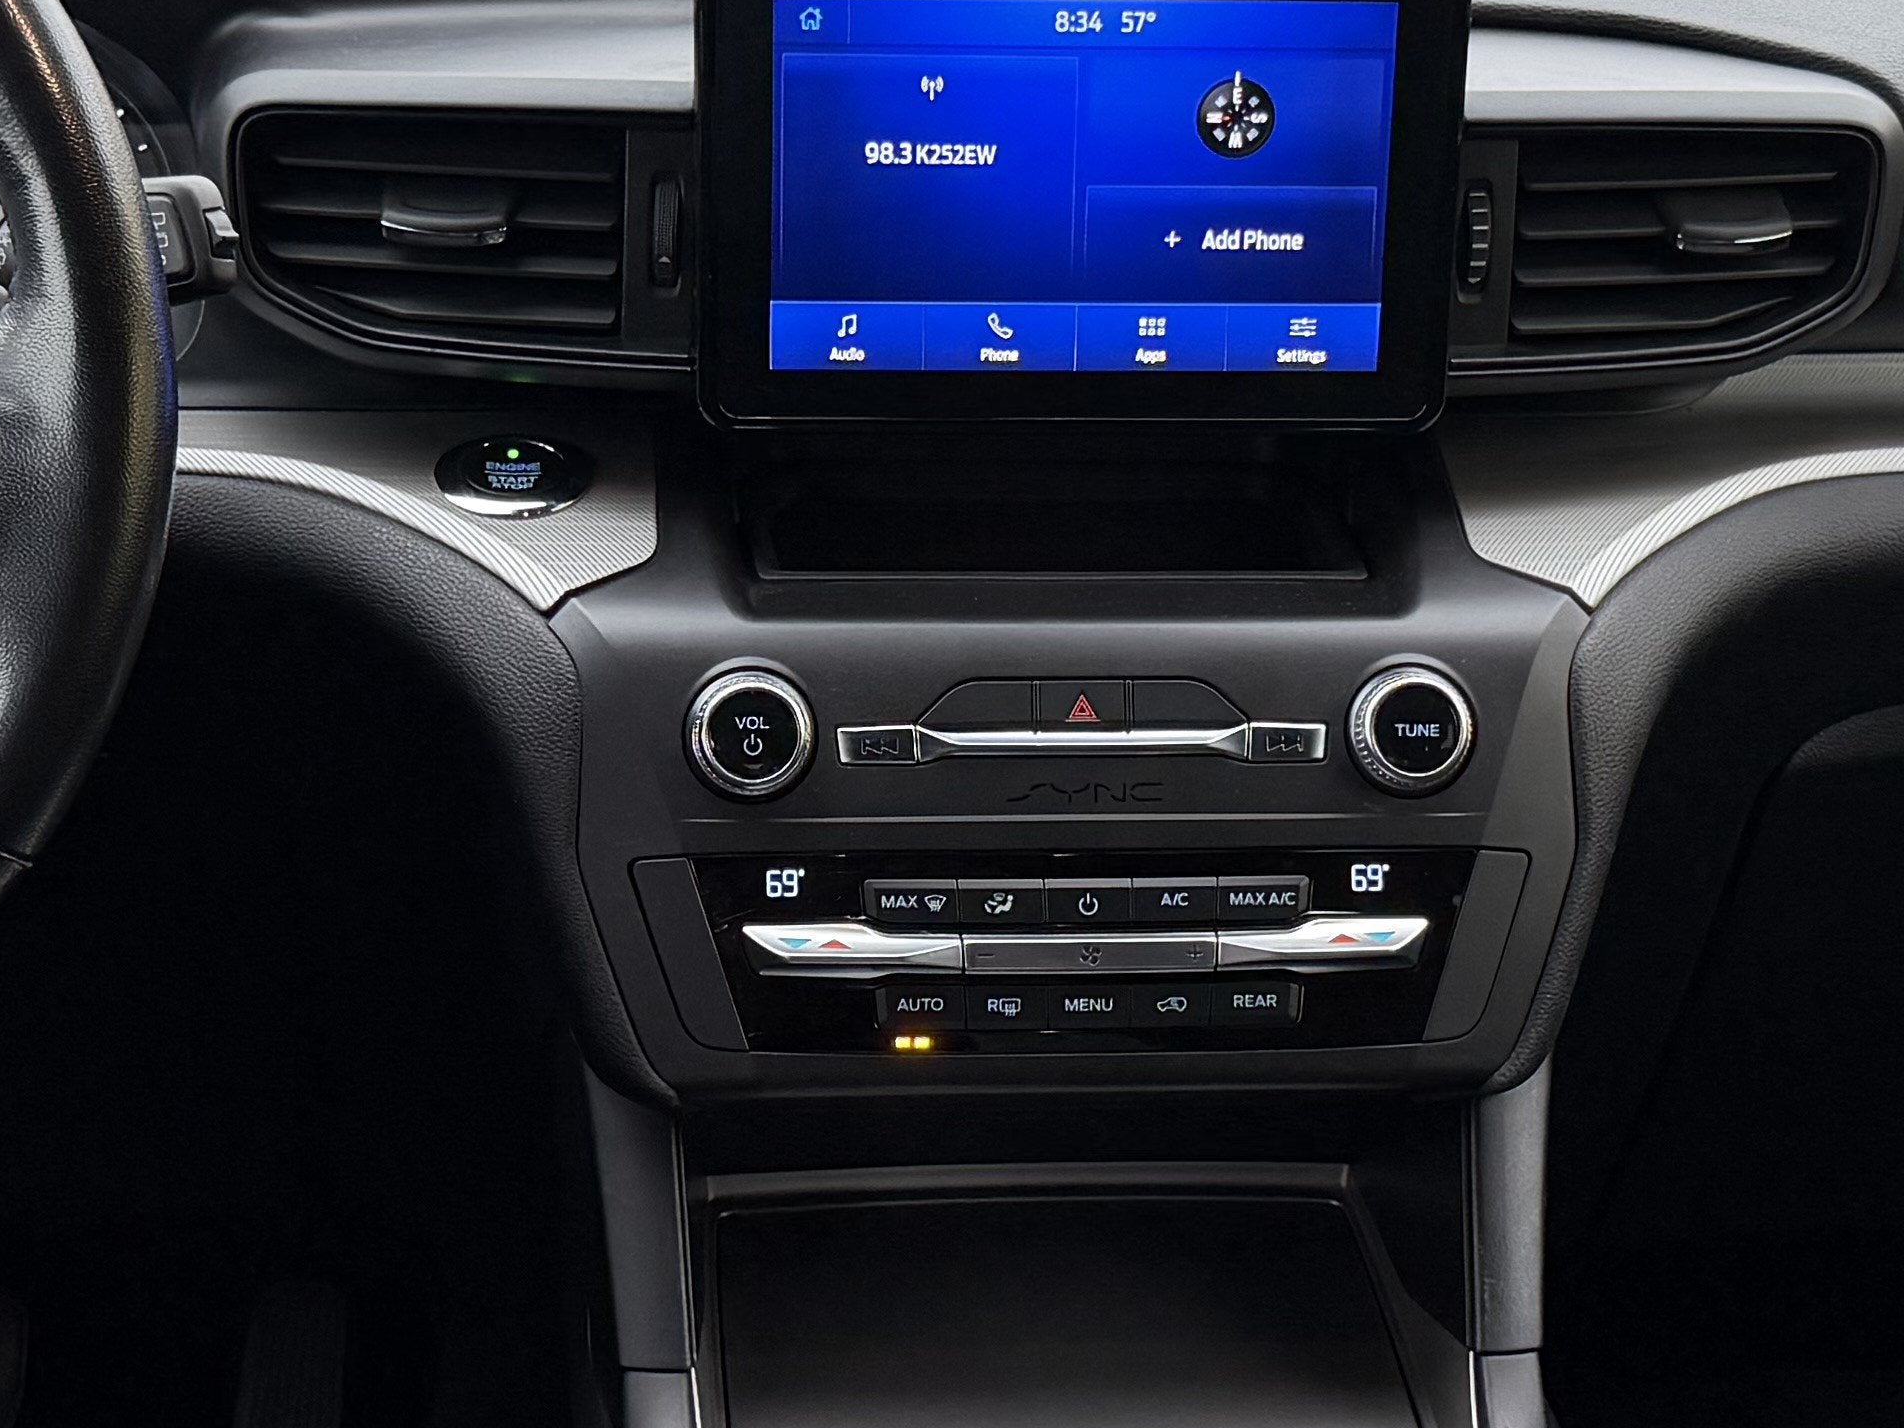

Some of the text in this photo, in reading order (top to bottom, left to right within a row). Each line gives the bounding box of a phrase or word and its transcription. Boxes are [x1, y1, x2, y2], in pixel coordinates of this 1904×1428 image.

[1055, 11, 1103, 33] 8:34
[865, 142, 997, 167] 98.3 K252EW
[1202, 229, 1304, 251] Add Phone
[829, 347, 866, 363] Audio
[980, 348, 1020, 363] Phone
[1136, 348, 1167, 365] Apps
[1277, 348, 1327, 366] Settings
[486, 461, 541, 471] ENGINE
[487, 475, 538, 483] START
[735, 716, 771, 731] VOL
[1395, 724, 1441, 738] TUNE
[1006, 782, 1165, 804] SYNC
[881, 895, 919, 910] MAX
[1160, 893, 1190, 907] A/C
[1229, 892, 1297, 907] MAX A/C
[897, 998, 945, 1013] AUTO
[1065, 999, 1114, 1013] MENU
[1233, 995, 1278, 1009] REAR
